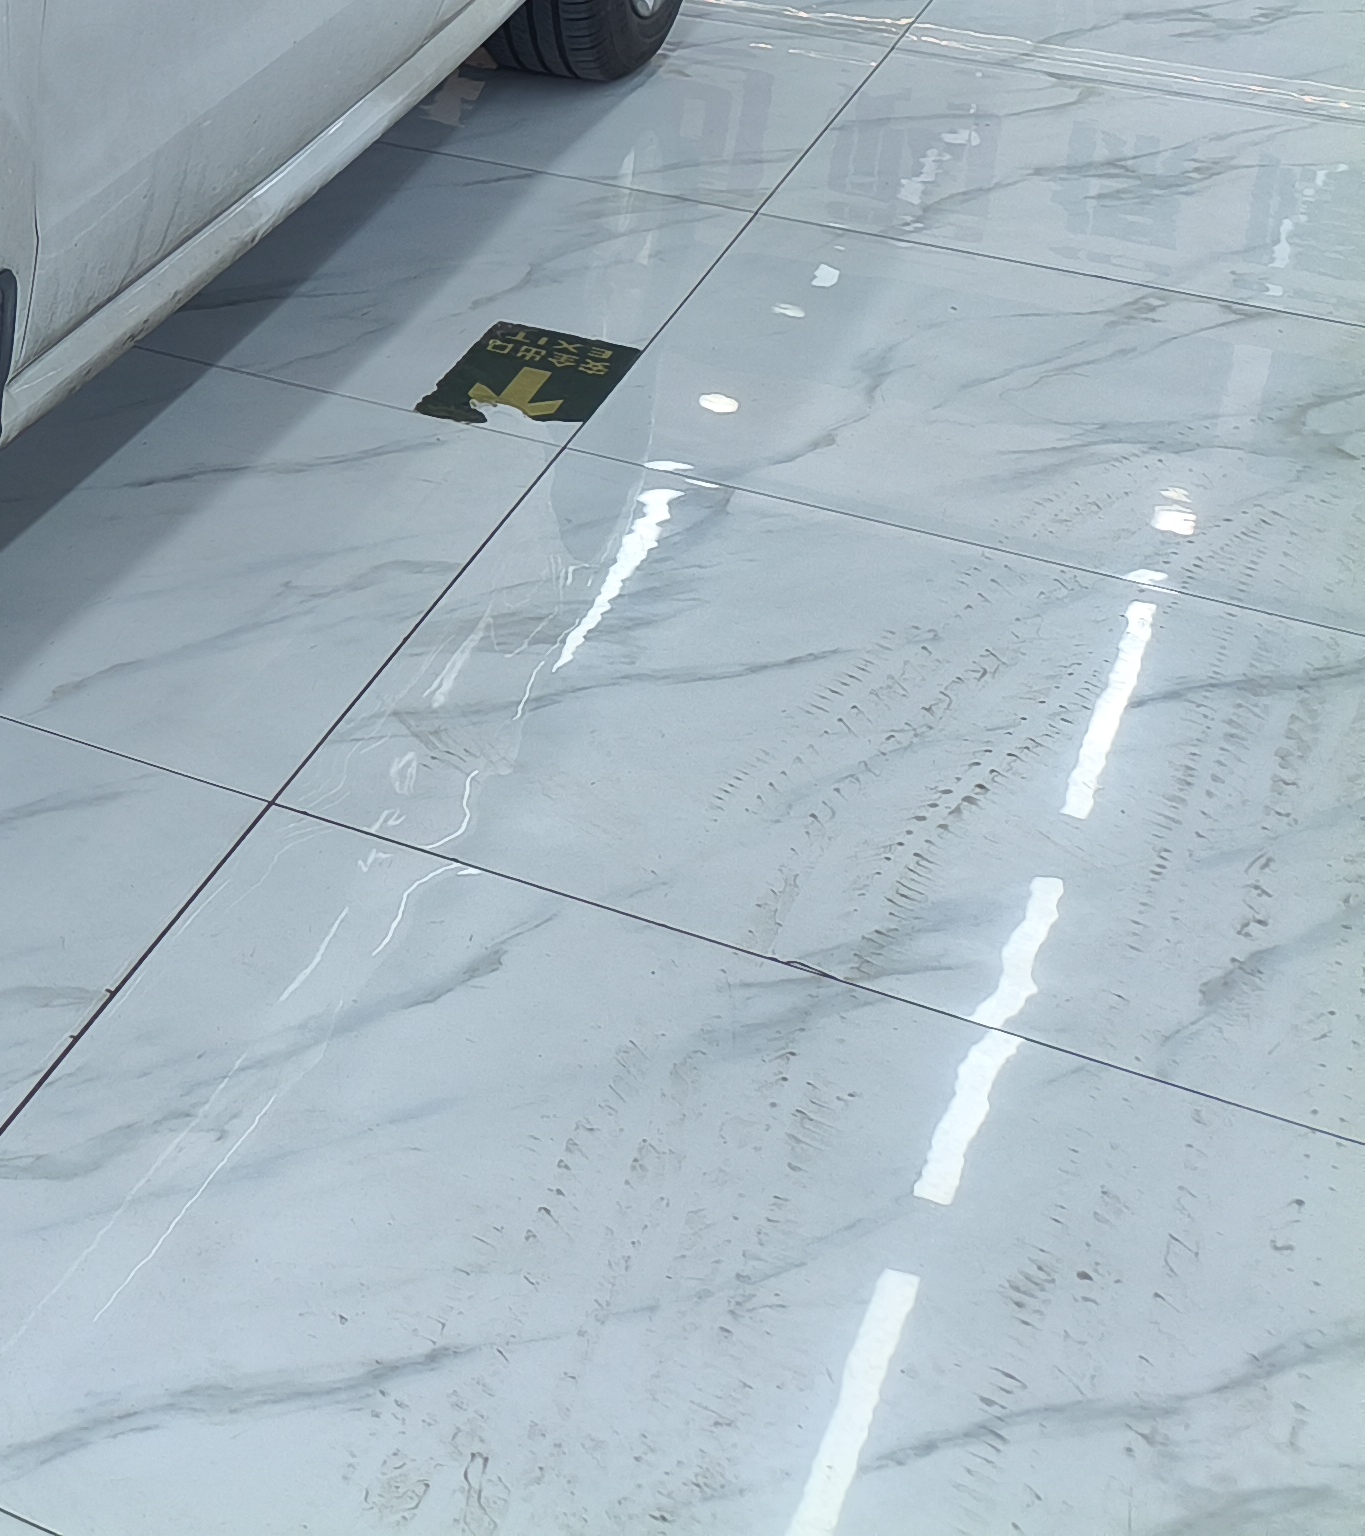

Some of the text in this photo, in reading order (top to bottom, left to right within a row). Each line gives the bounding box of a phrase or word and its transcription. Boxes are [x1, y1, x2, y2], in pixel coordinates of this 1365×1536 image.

[486, 338, 612, 376] 安全出口
[505, 330, 613, 359] EXIT
